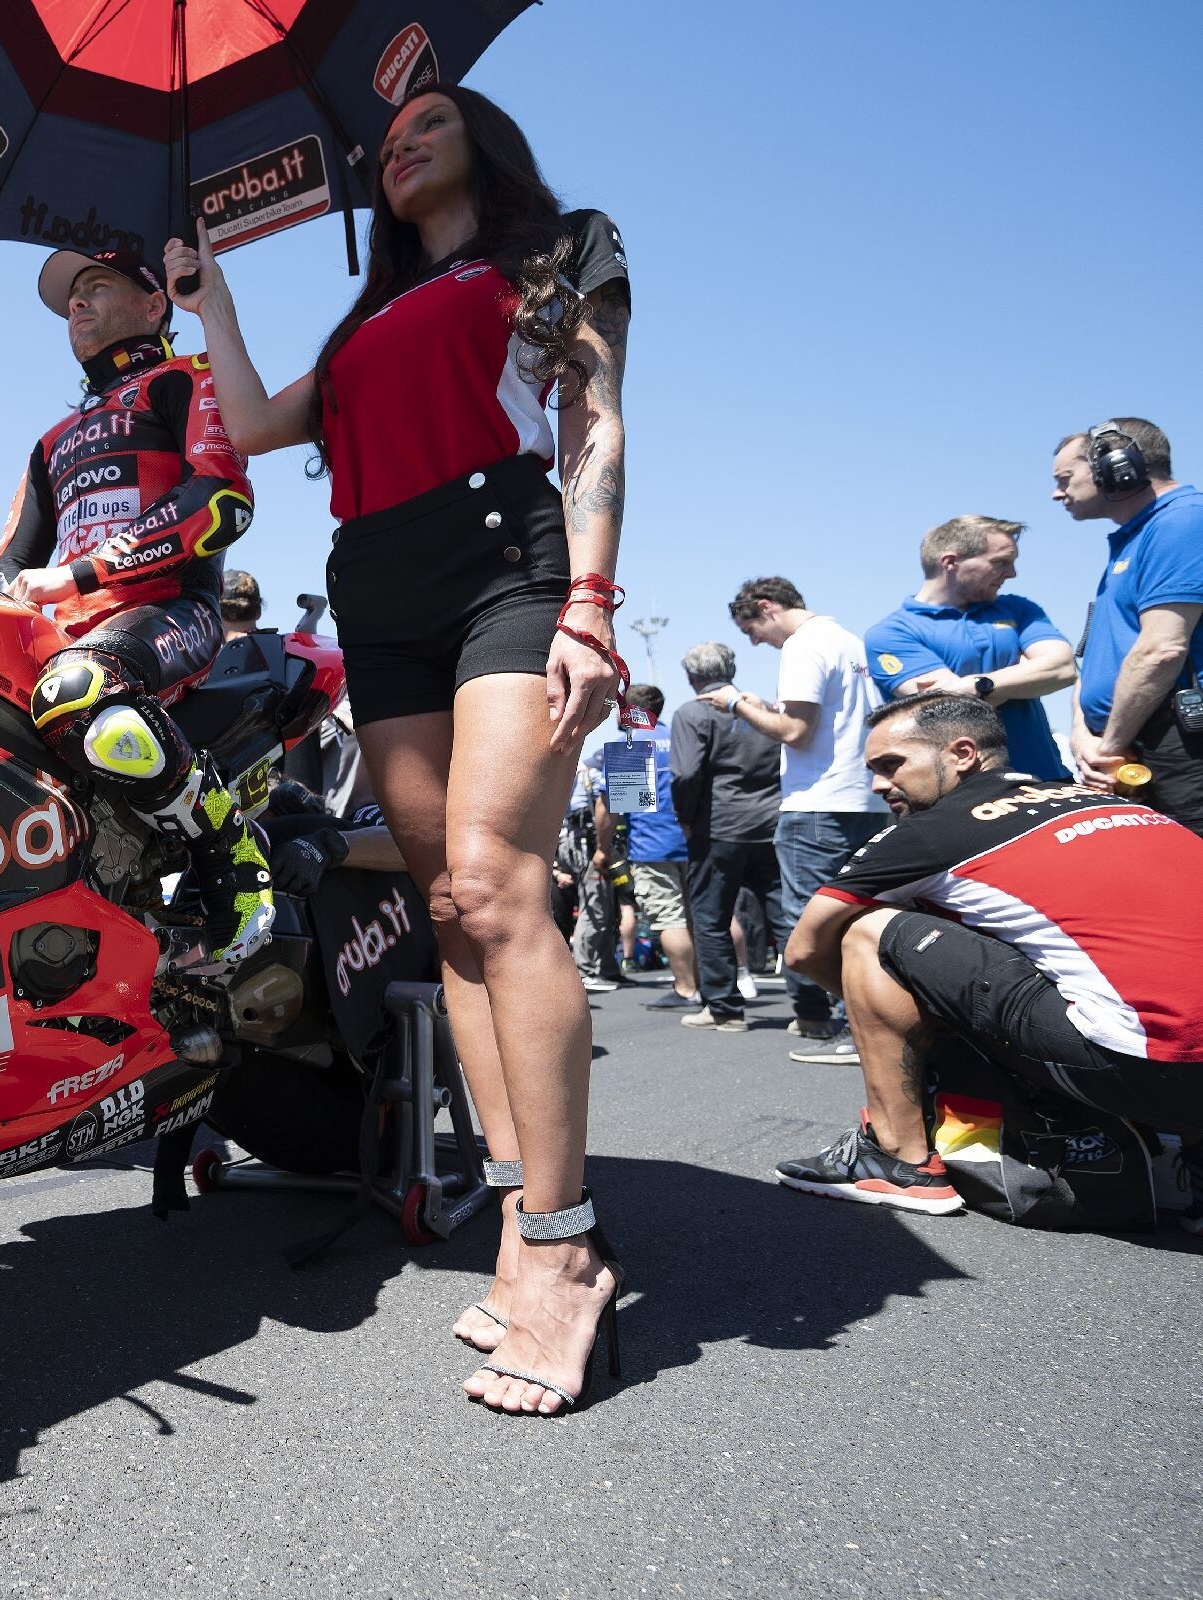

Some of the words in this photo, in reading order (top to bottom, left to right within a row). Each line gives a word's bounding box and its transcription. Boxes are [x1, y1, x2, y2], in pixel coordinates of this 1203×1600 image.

[380, 31, 419, 90] DUCATI
[202, 148, 306, 216] aruba.it
[217, 219, 244, 238] Ducati
[242, 206, 284, 229] Superbike
[282, 199, 303, 215] Team
[56, 465, 122, 510] Lenovo
[102, 501, 130, 517] ups
[115, 542, 173, 570] Lenovo
[154, 602, 214, 664] aruba.it
[99, 1079, 145, 1122] D.I.D
[103, 1099, 145, 1135] NGK
[153, 1089, 215, 1138] FIAMM
[68, 1123, 96, 1150] STM
